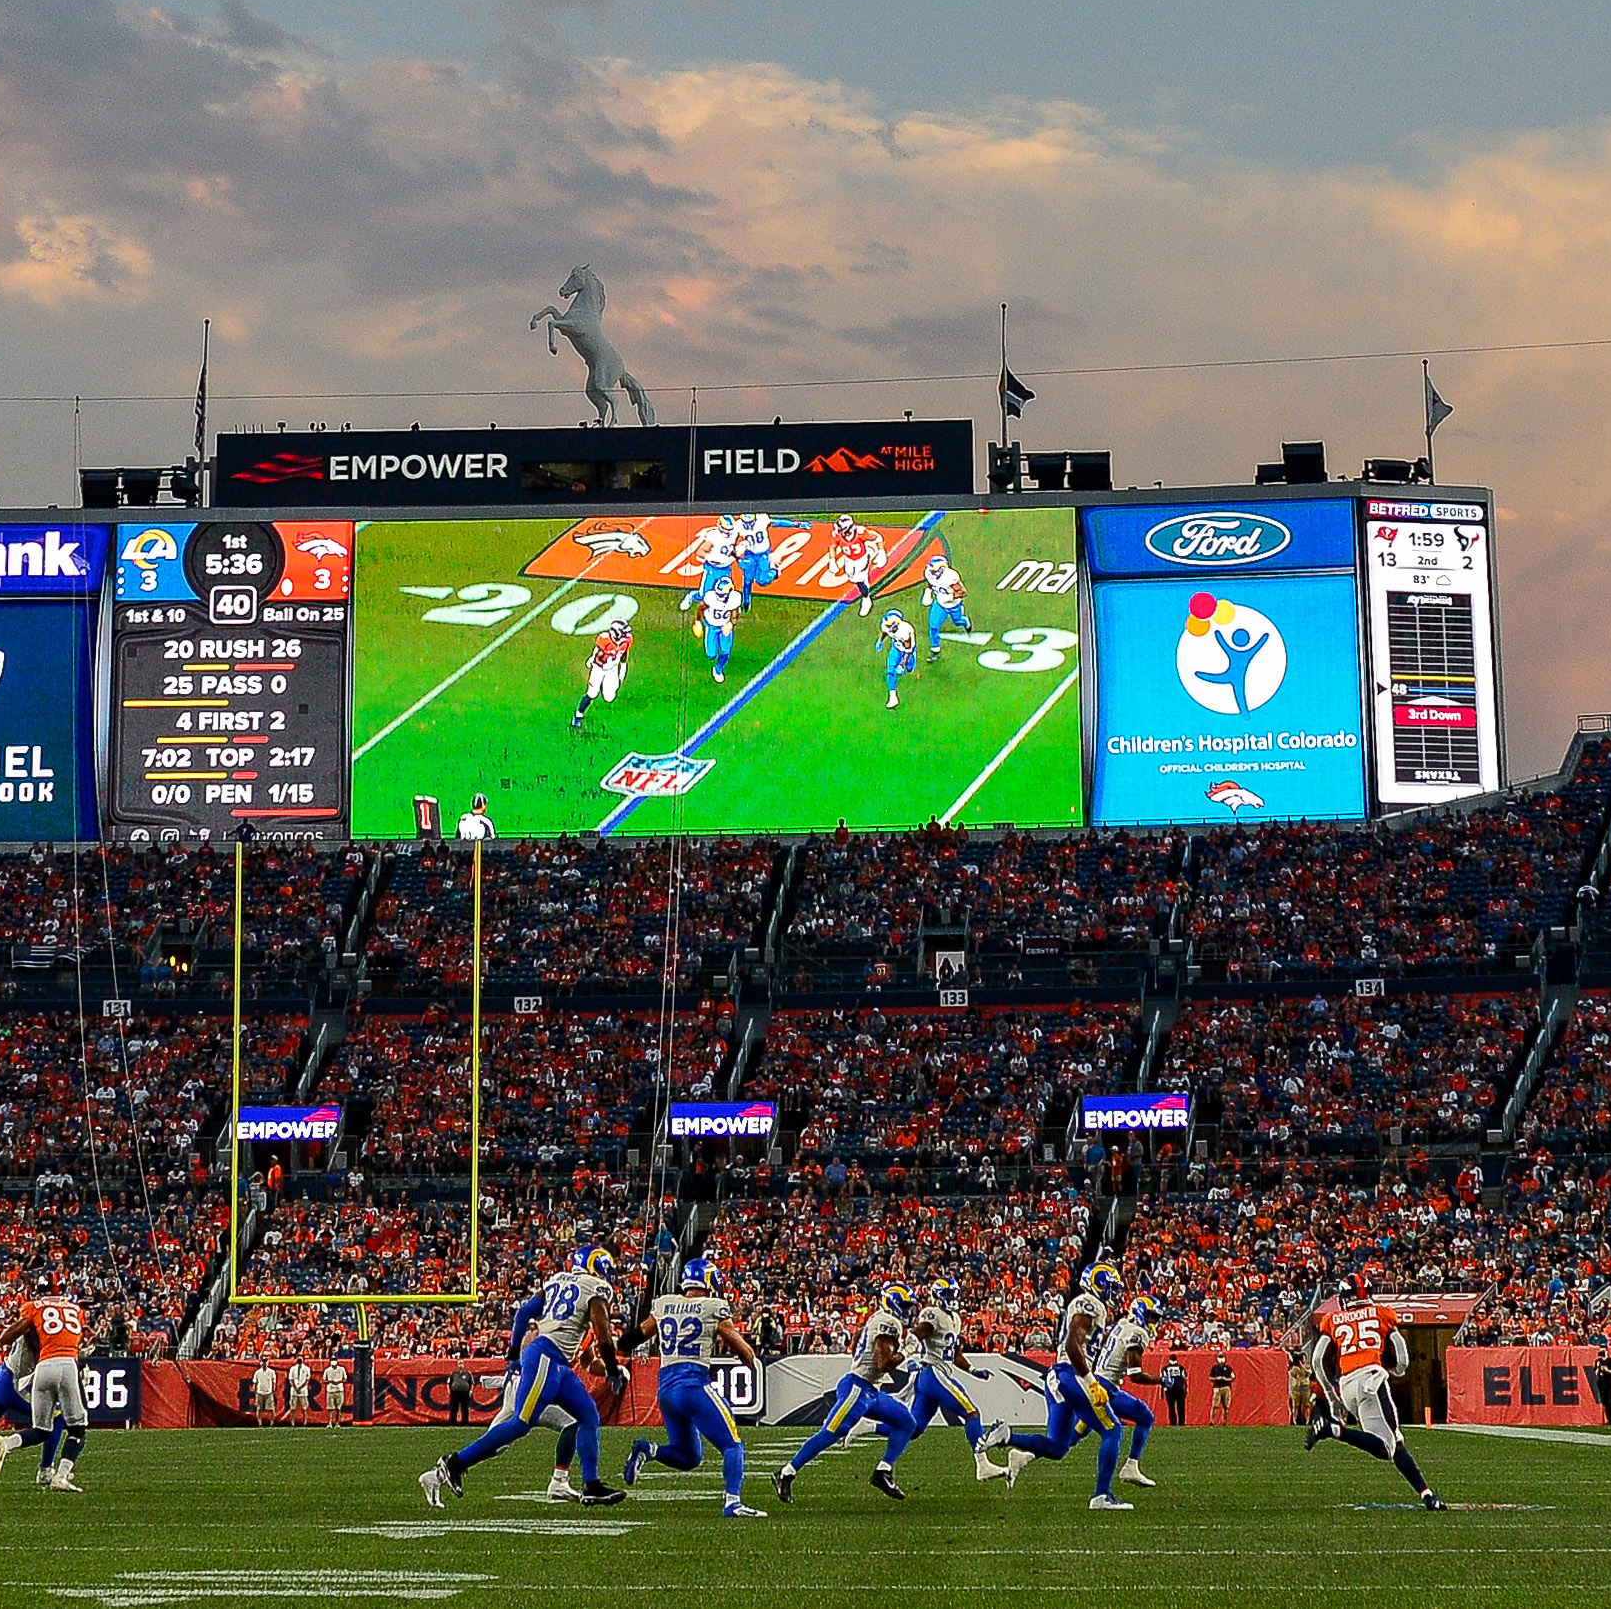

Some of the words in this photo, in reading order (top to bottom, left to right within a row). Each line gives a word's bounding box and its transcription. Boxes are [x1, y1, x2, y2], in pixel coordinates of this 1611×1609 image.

[896, 447, 931, 457] MILE
[330, 453, 508, 481] EMPOWER
[704, 449, 800, 474] FIELD
[895, 459, 934, 471] HIGH
[1370, 503, 1428, 515] BETFRED
[1436, 507, 1477, 517] SPORTS
[222, 534, 248, 549] 1st
[1173, 520, 1262, 556] Ford
[1408, 533, 1444, 547] 1:59
[205, 553, 262, 575] 5:36
[1378, 553, 1396, 567] 13
[1418, 557, 1438, 565] 2nd
[1463, 557, 1473, 569] 2
[140, 571, 158, 591] 3
[314, 569, 330, 589] 3
[216, 594, 250, 615] 40
[126, 609, 149, 623] 1st
[151, 609, 165, 623] &
[166, 609, 186, 623] 10
[264, 608, 292, 622] Ball
[296, 608, 320, 621] On
[323, 607, 344, 621] 25
[164, 641, 194, 659] 20
[200, 641, 264, 659] RUSH
[272, 639, 301, 658] 26
[977, 626, 1078, 672] 3
[164, 676, 193, 694] 25
[202, 676, 262, 694] PASS
[270, 675, 286, 693] 0
[1392, 683, 1407, 695] 48
[176, 712, 192, 731] 4
[198, 712, 263, 731] FIRST
[270, 711, 285, 730] 2
[1408, 709, 1427, 719] 3rd
[1430, 710, 1462, 721] Down
[1107, 735, 1194, 755] Children's
[1198, 733, 1272, 754] Hospital
[1276, 731, 1357, 749] Colorado
[142, 749, 192, 767] 7:02
[206, 749, 254, 767] TOP
[269, 747, 315, 767] 2:17
[1159, 763, 1202, 773] OFFICIAL
[1261, 761, 1306, 771] HOSPITAL
[1414, 771, 1461, 781] TEXANS
[614, 771, 680, 792] NFL
[152, 784, 190, 804] 0/0
[206, 785, 252, 803] PEN
[268, 783, 314, 803] 1/15
[419, 802, 430, 830] 1
[1358, 981, 1382, 995] 134
[517, 999, 540, 1011] 132
[942, 992, 966, 1005] 133
[672, 1117, 772, 1135] EMPOWER
[1084, 1109, 1188, 1129] EMPOWER
[236, 1122, 338, 1139] EMPOWER
[542, 1283, 580, 1321] 78
[664, 1303, 702, 1315] WILLIAMS
[42, 1307, 82, 1335] 85
[1332, 1308, 1368, 1325] GORDON
[660, 1317, 703, 1356] 92
[1334, 1319, 1381, 1355] 25
